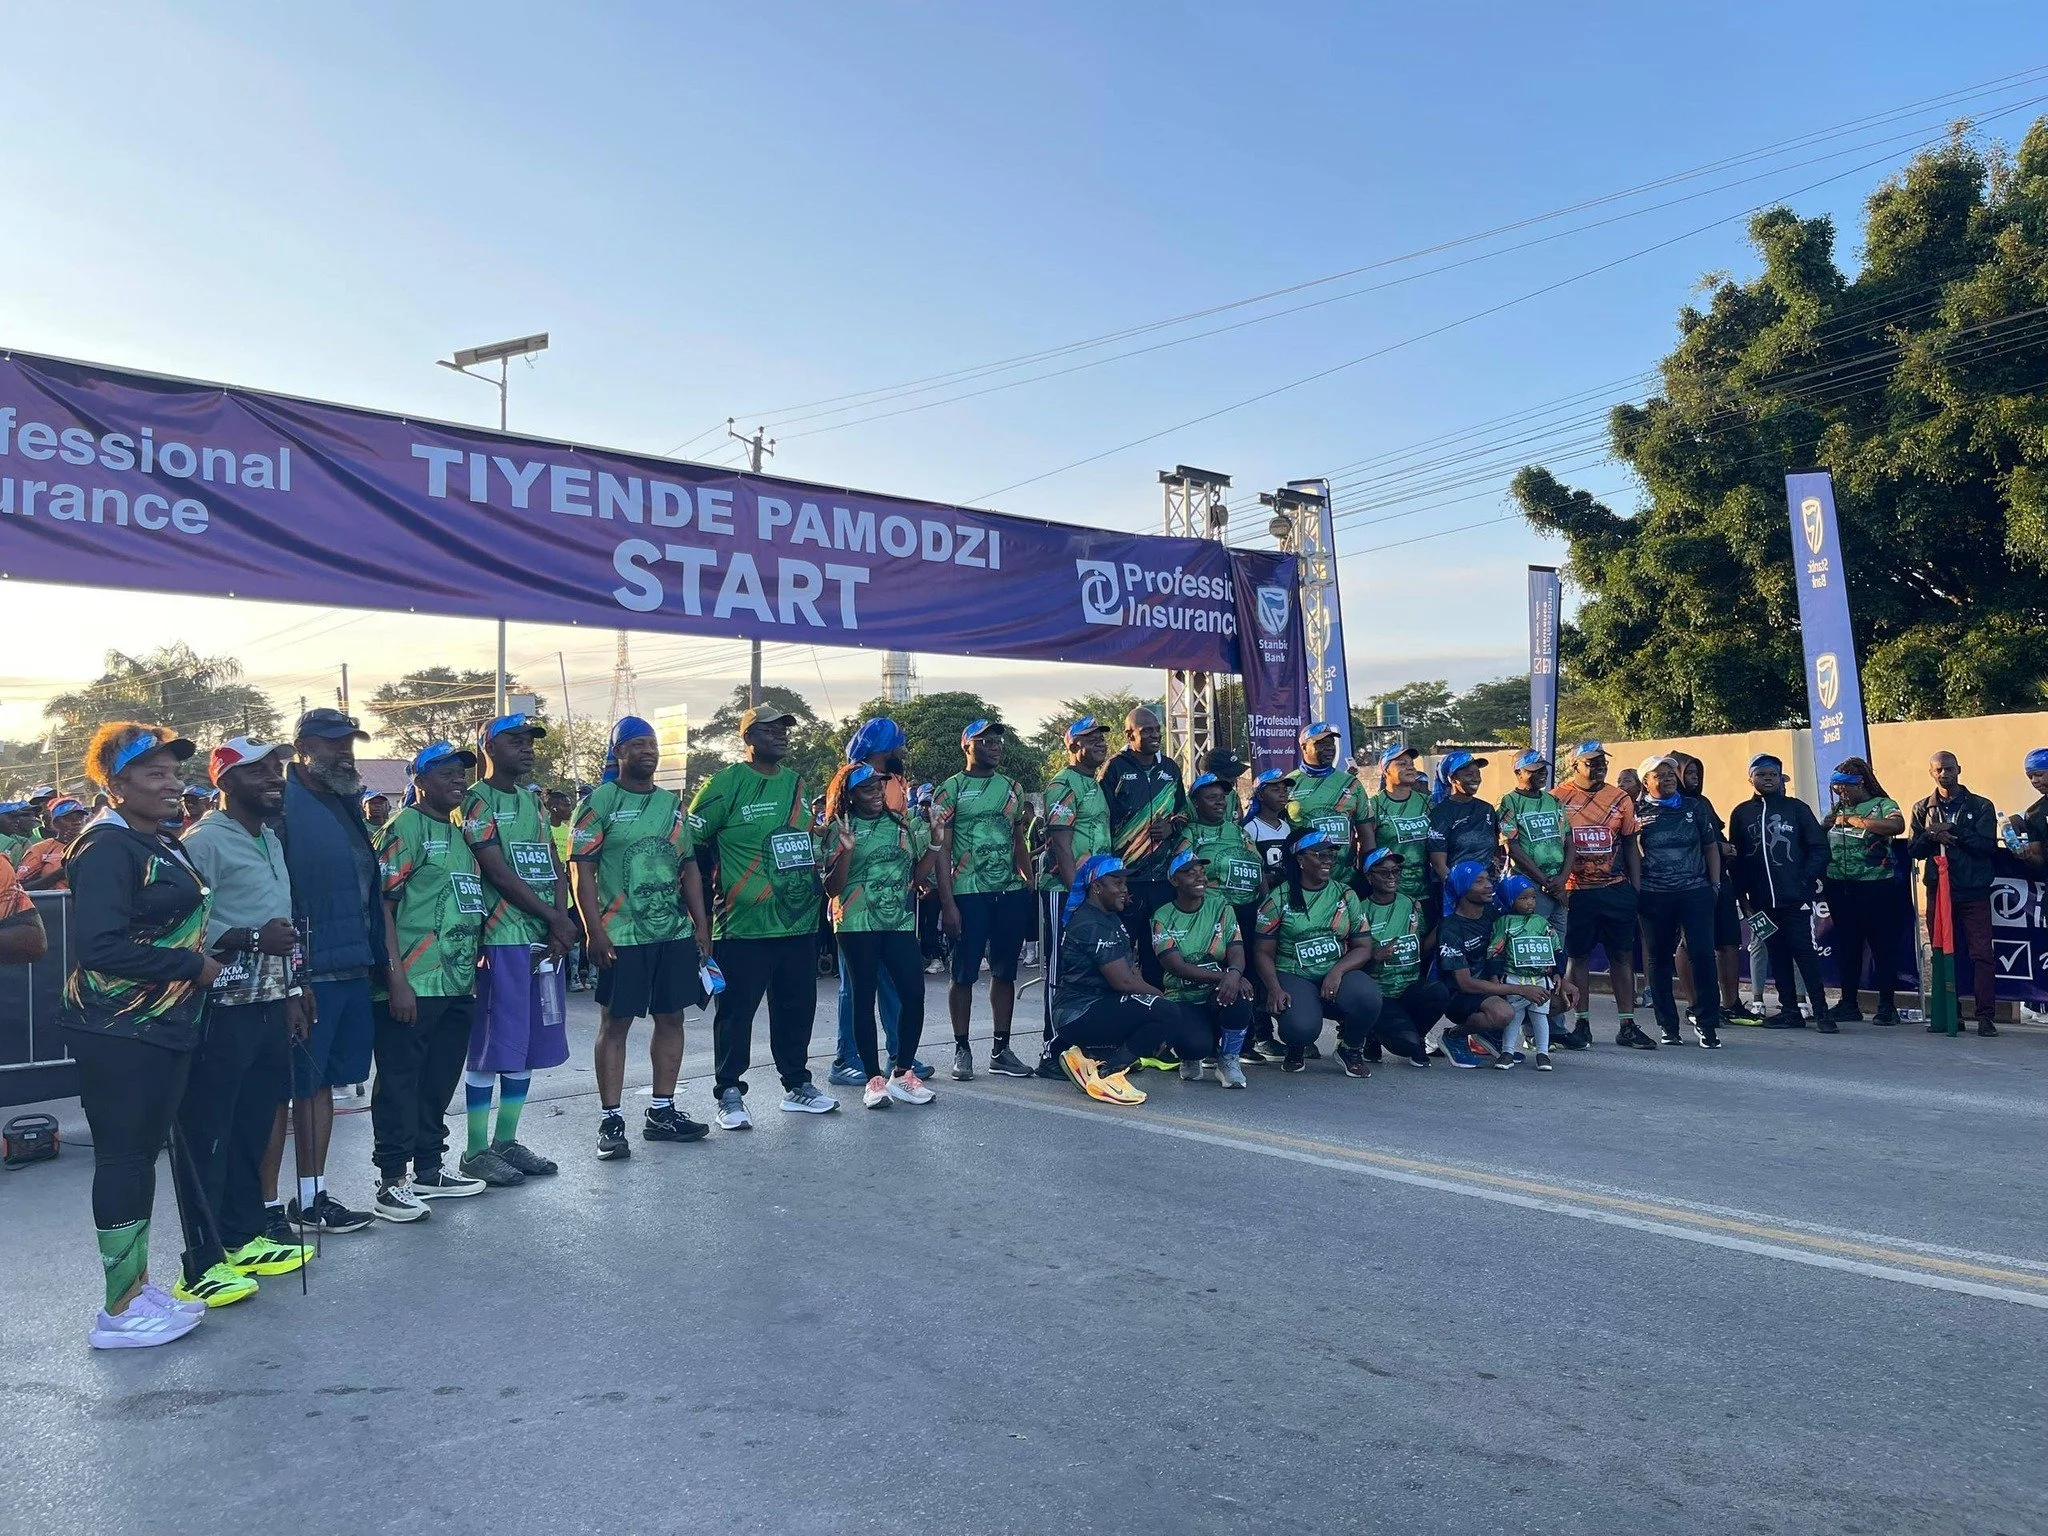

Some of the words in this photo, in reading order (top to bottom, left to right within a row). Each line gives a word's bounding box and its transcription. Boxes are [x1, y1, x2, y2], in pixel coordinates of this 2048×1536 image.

[411, 444, 734, 536] TIYENDE
[758, 495, 1000, 571] PAMODZI
[612, 538, 870, 631] START
[1128, 596, 1238, 636] Insuranc
[1264, 652, 1286, 663] Bank
[1319, 822, 1345, 832] 51911
[1398, 820, 1429, 831] 50801
[1530, 817, 1555, 829] 51227
[776, 840, 810, 854] 50803
[516, 851, 549, 864] 51452
[1233, 866, 1258, 879] 51916
[1300, 942, 1337, 959] 50830
[1517, 943, 1549, 954] 51596
